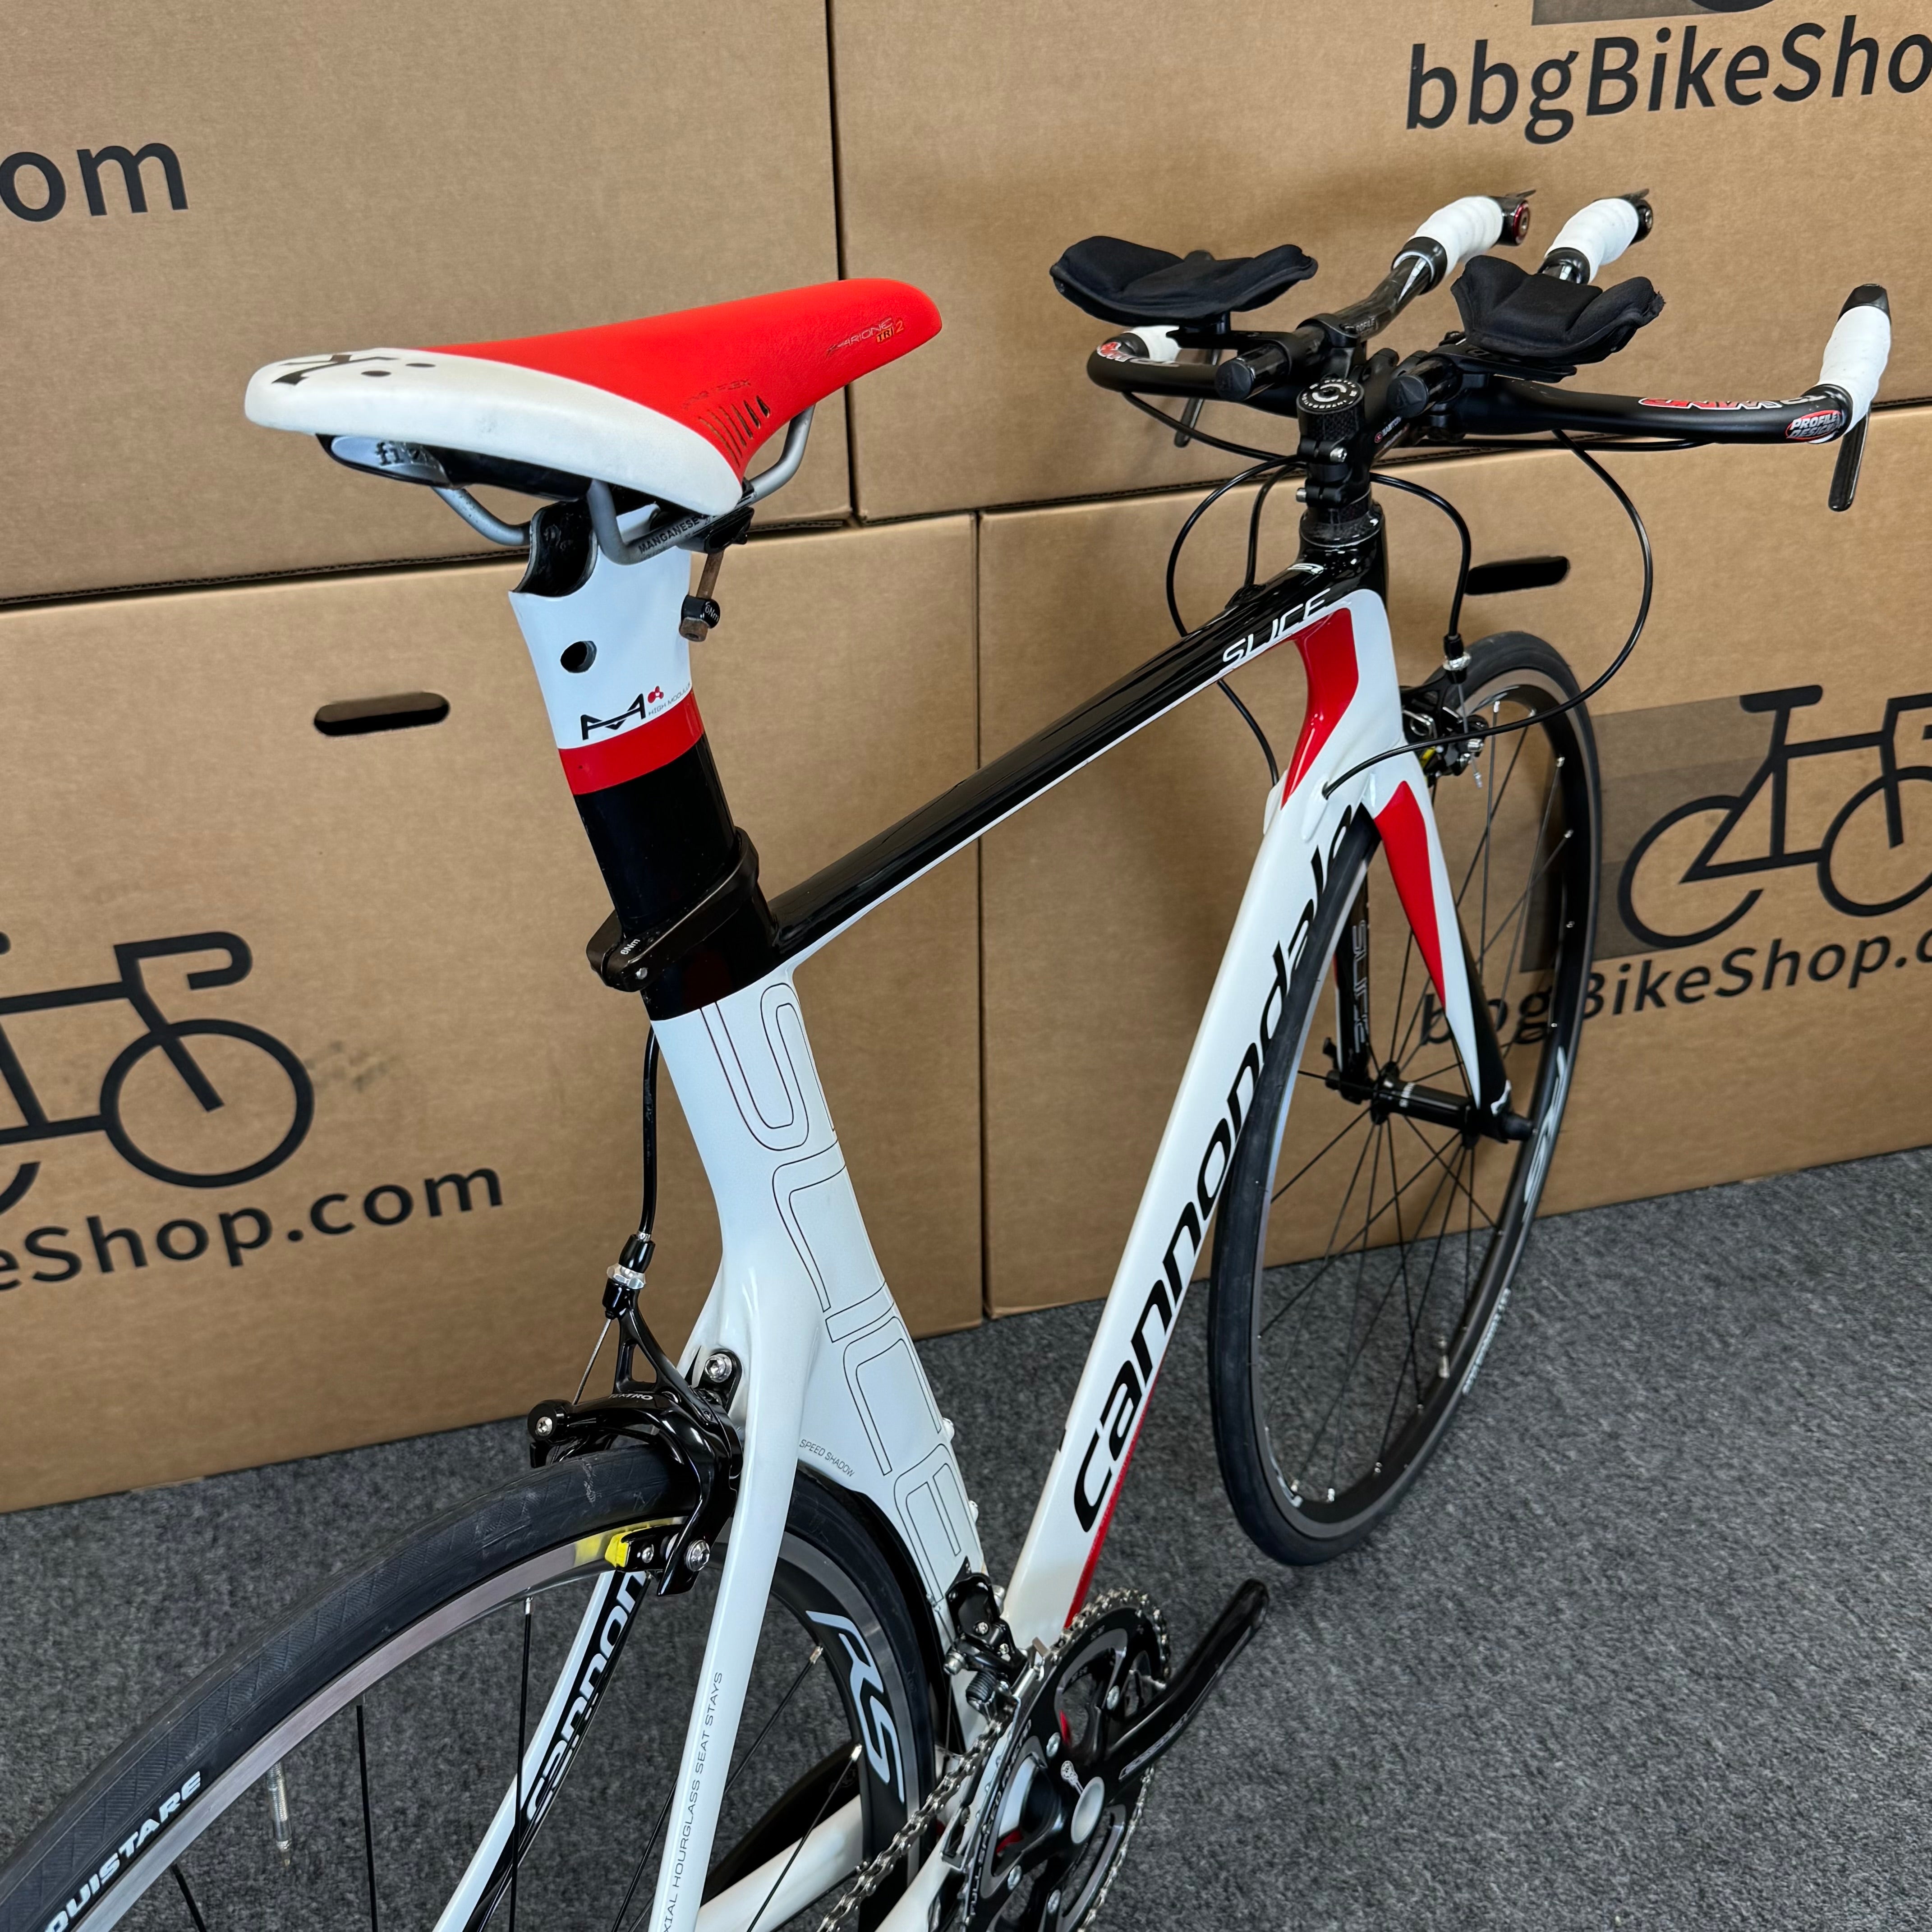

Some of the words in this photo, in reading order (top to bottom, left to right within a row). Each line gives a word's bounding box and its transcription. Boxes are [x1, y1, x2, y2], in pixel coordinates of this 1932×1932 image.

[1406, 14, 1932, 144] bbgBikeSho
[0, 143, 189, 222] om
[1790, 413, 1837, 430] PROFILE
[638, 516, 699, 554] MANGANESE
[648, 704, 667, 716] HIGH
[799, 1439, 825, 1456] SPEED
[824, 1452, 855, 1477] SHADOW
[672, 1780, 700, 1889] HOURGLASS
[695, 1730, 710, 1775] SEAT
[705, 1671, 722, 1726] STAYS
